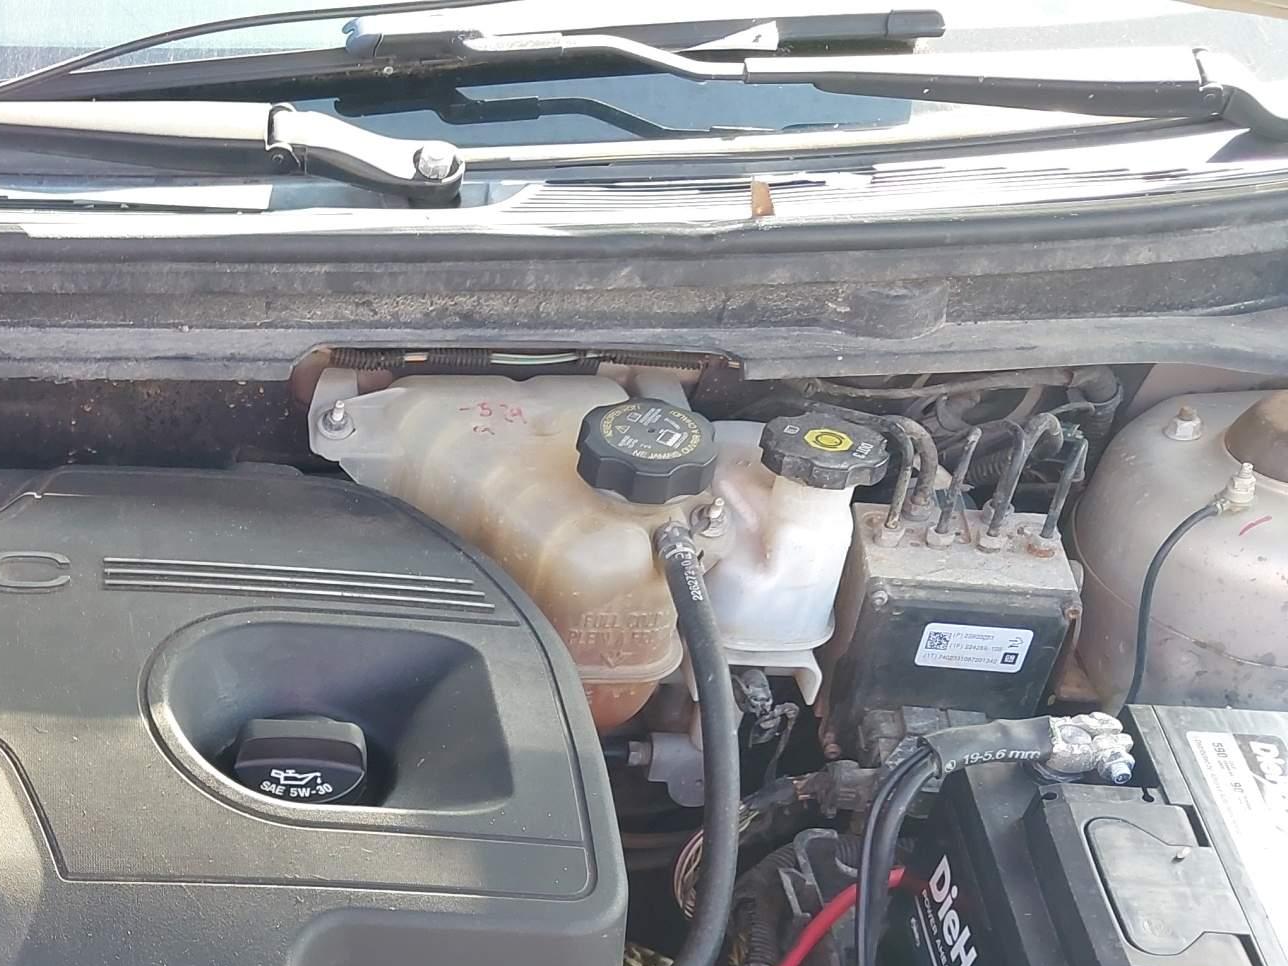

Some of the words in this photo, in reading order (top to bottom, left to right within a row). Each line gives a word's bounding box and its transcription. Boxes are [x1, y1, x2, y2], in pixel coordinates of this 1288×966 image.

[963, 749, 1007, 765] 19-5.6
[1008, 750, 1041, 759] mm
[260, 781, 285, 795] SAE
[289, 782, 333, 798] 5W-30
[921, 888, 938, 936] POWER
